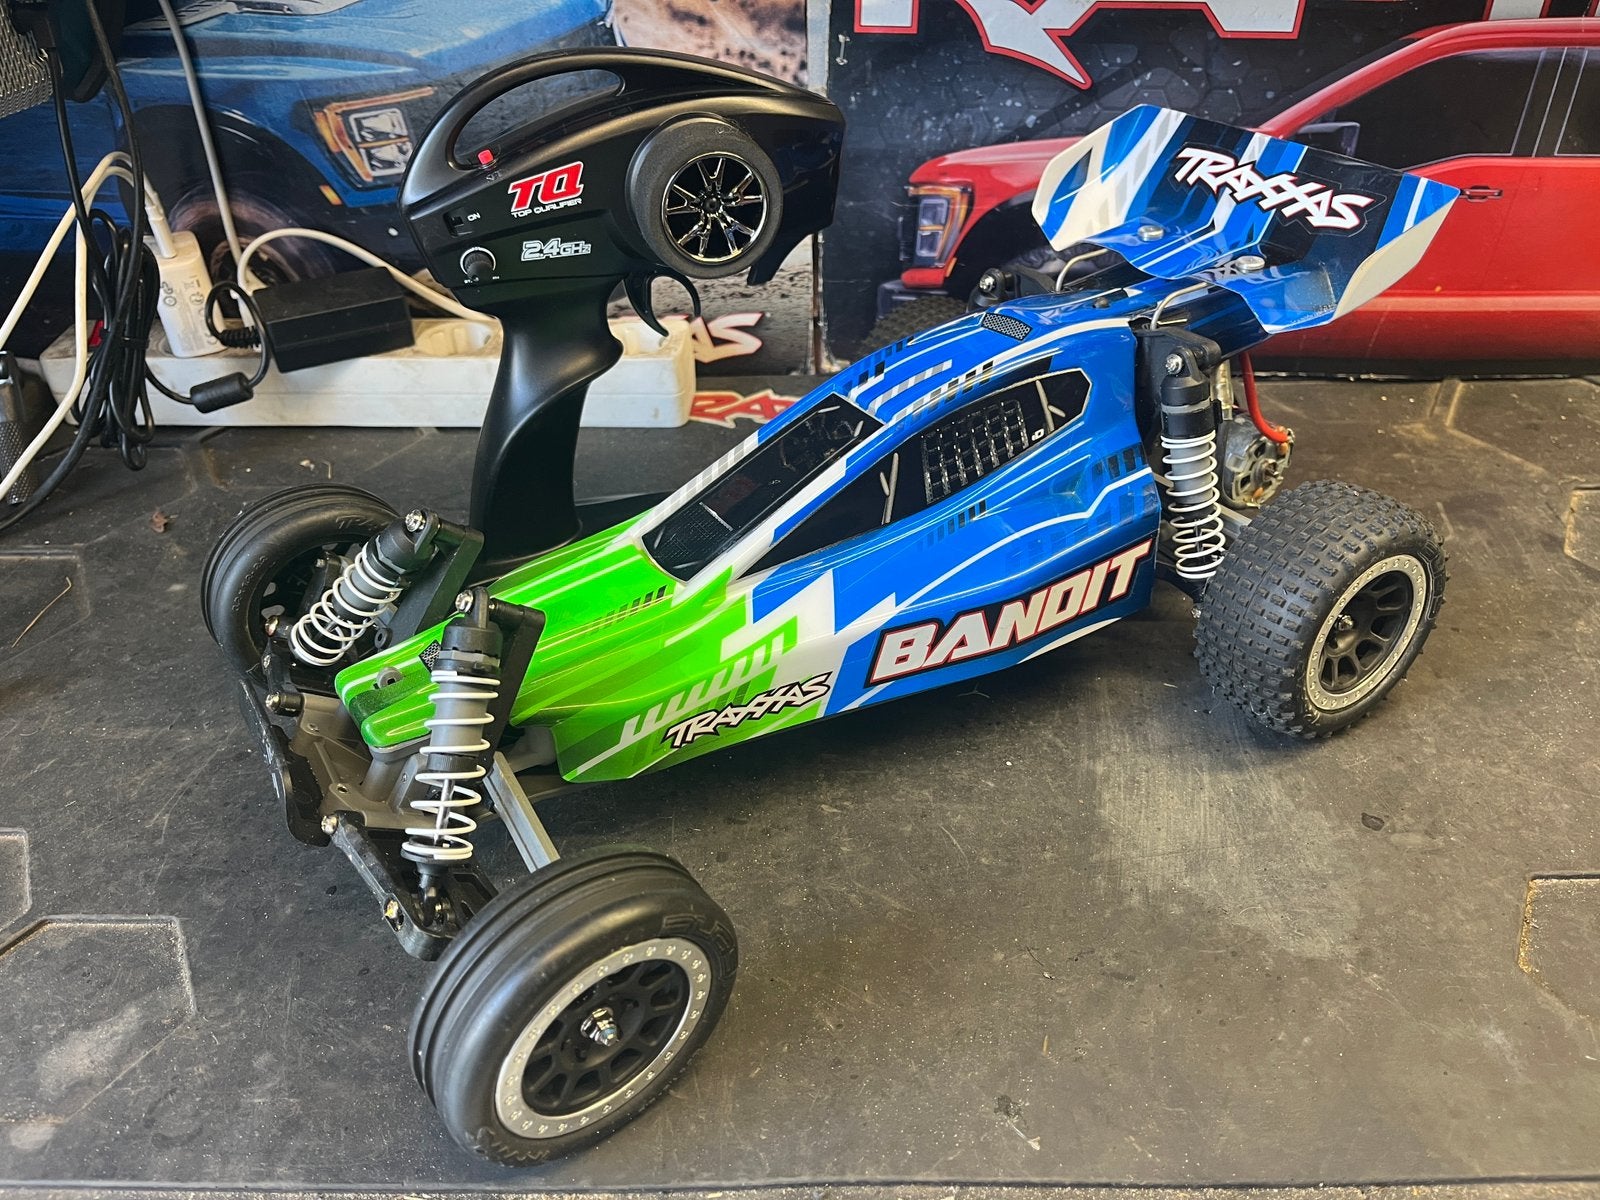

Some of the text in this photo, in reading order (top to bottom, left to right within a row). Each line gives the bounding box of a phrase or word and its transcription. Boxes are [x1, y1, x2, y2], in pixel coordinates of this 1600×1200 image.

[467, 212, 481, 222] ON
[507, 160, 585, 213] TQ
[510, 197, 583, 219] TOP QUALIFIER
[1174, 147, 1375, 230] TRAXXAS
[868, 538, 1153, 684] BANDIT
[661, 671, 833, 748] TRAXXAS
